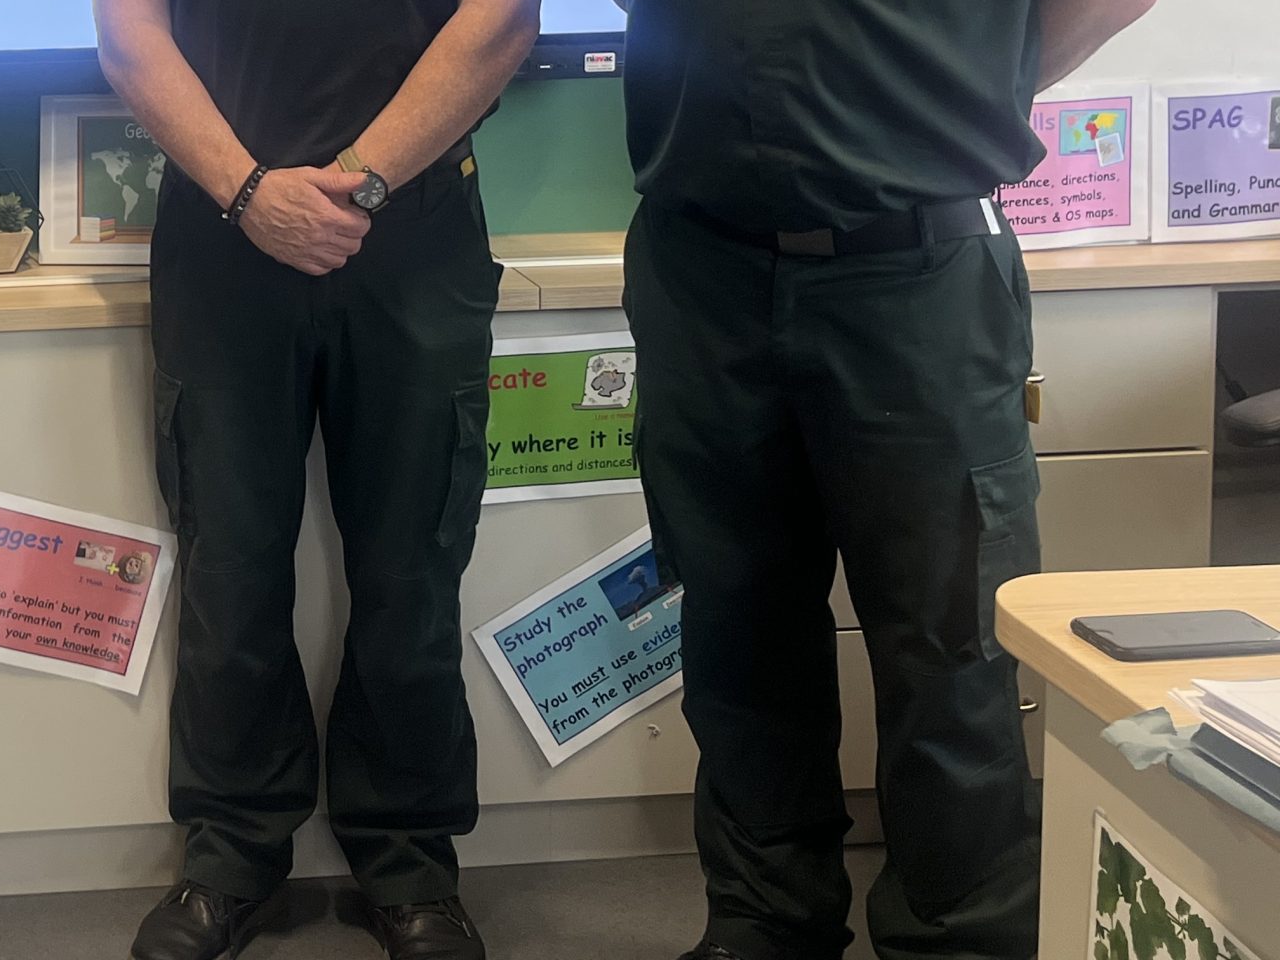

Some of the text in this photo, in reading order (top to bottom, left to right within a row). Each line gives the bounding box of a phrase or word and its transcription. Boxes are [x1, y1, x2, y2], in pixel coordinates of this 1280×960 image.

[1172, 106, 1243, 131] SPAG
[1061, 171, 1120, 186] directions,
[1172, 179, 1241, 199] Spelling,
[1061, 190, 1106, 206] symbols,
[1172, 202, 1279, 219] and Grammar
[1052, 212, 1060, 222] &
[1066, 210, 1081, 222] OS
[1085, 208, 1118, 220] maps.
[512, 433, 578, 454] where
[591, 430, 607, 448] it
[618, 428, 633, 446] is
[488, 457, 633, 477] directions and distances
[61, 602, 81, 616] but
[84, 608, 105, 623] you
[108, 615, 137, 629] must
[503, 595, 588, 652] Study the
[5, 627, 32, 643] your
[35, 634, 57, 647] own
[62, 636, 124, 664] knowledge.
[73, 623, 101, 638] from
[112, 631, 131, 646] the
[516, 612, 609, 678] photograph
[538, 691, 568, 714] You
[571, 666, 608, 696] must
[611, 650, 638, 670] use
[642, 621, 682, 653] evide
[552, 705, 590, 734] from
[591, 687, 618, 708] the
